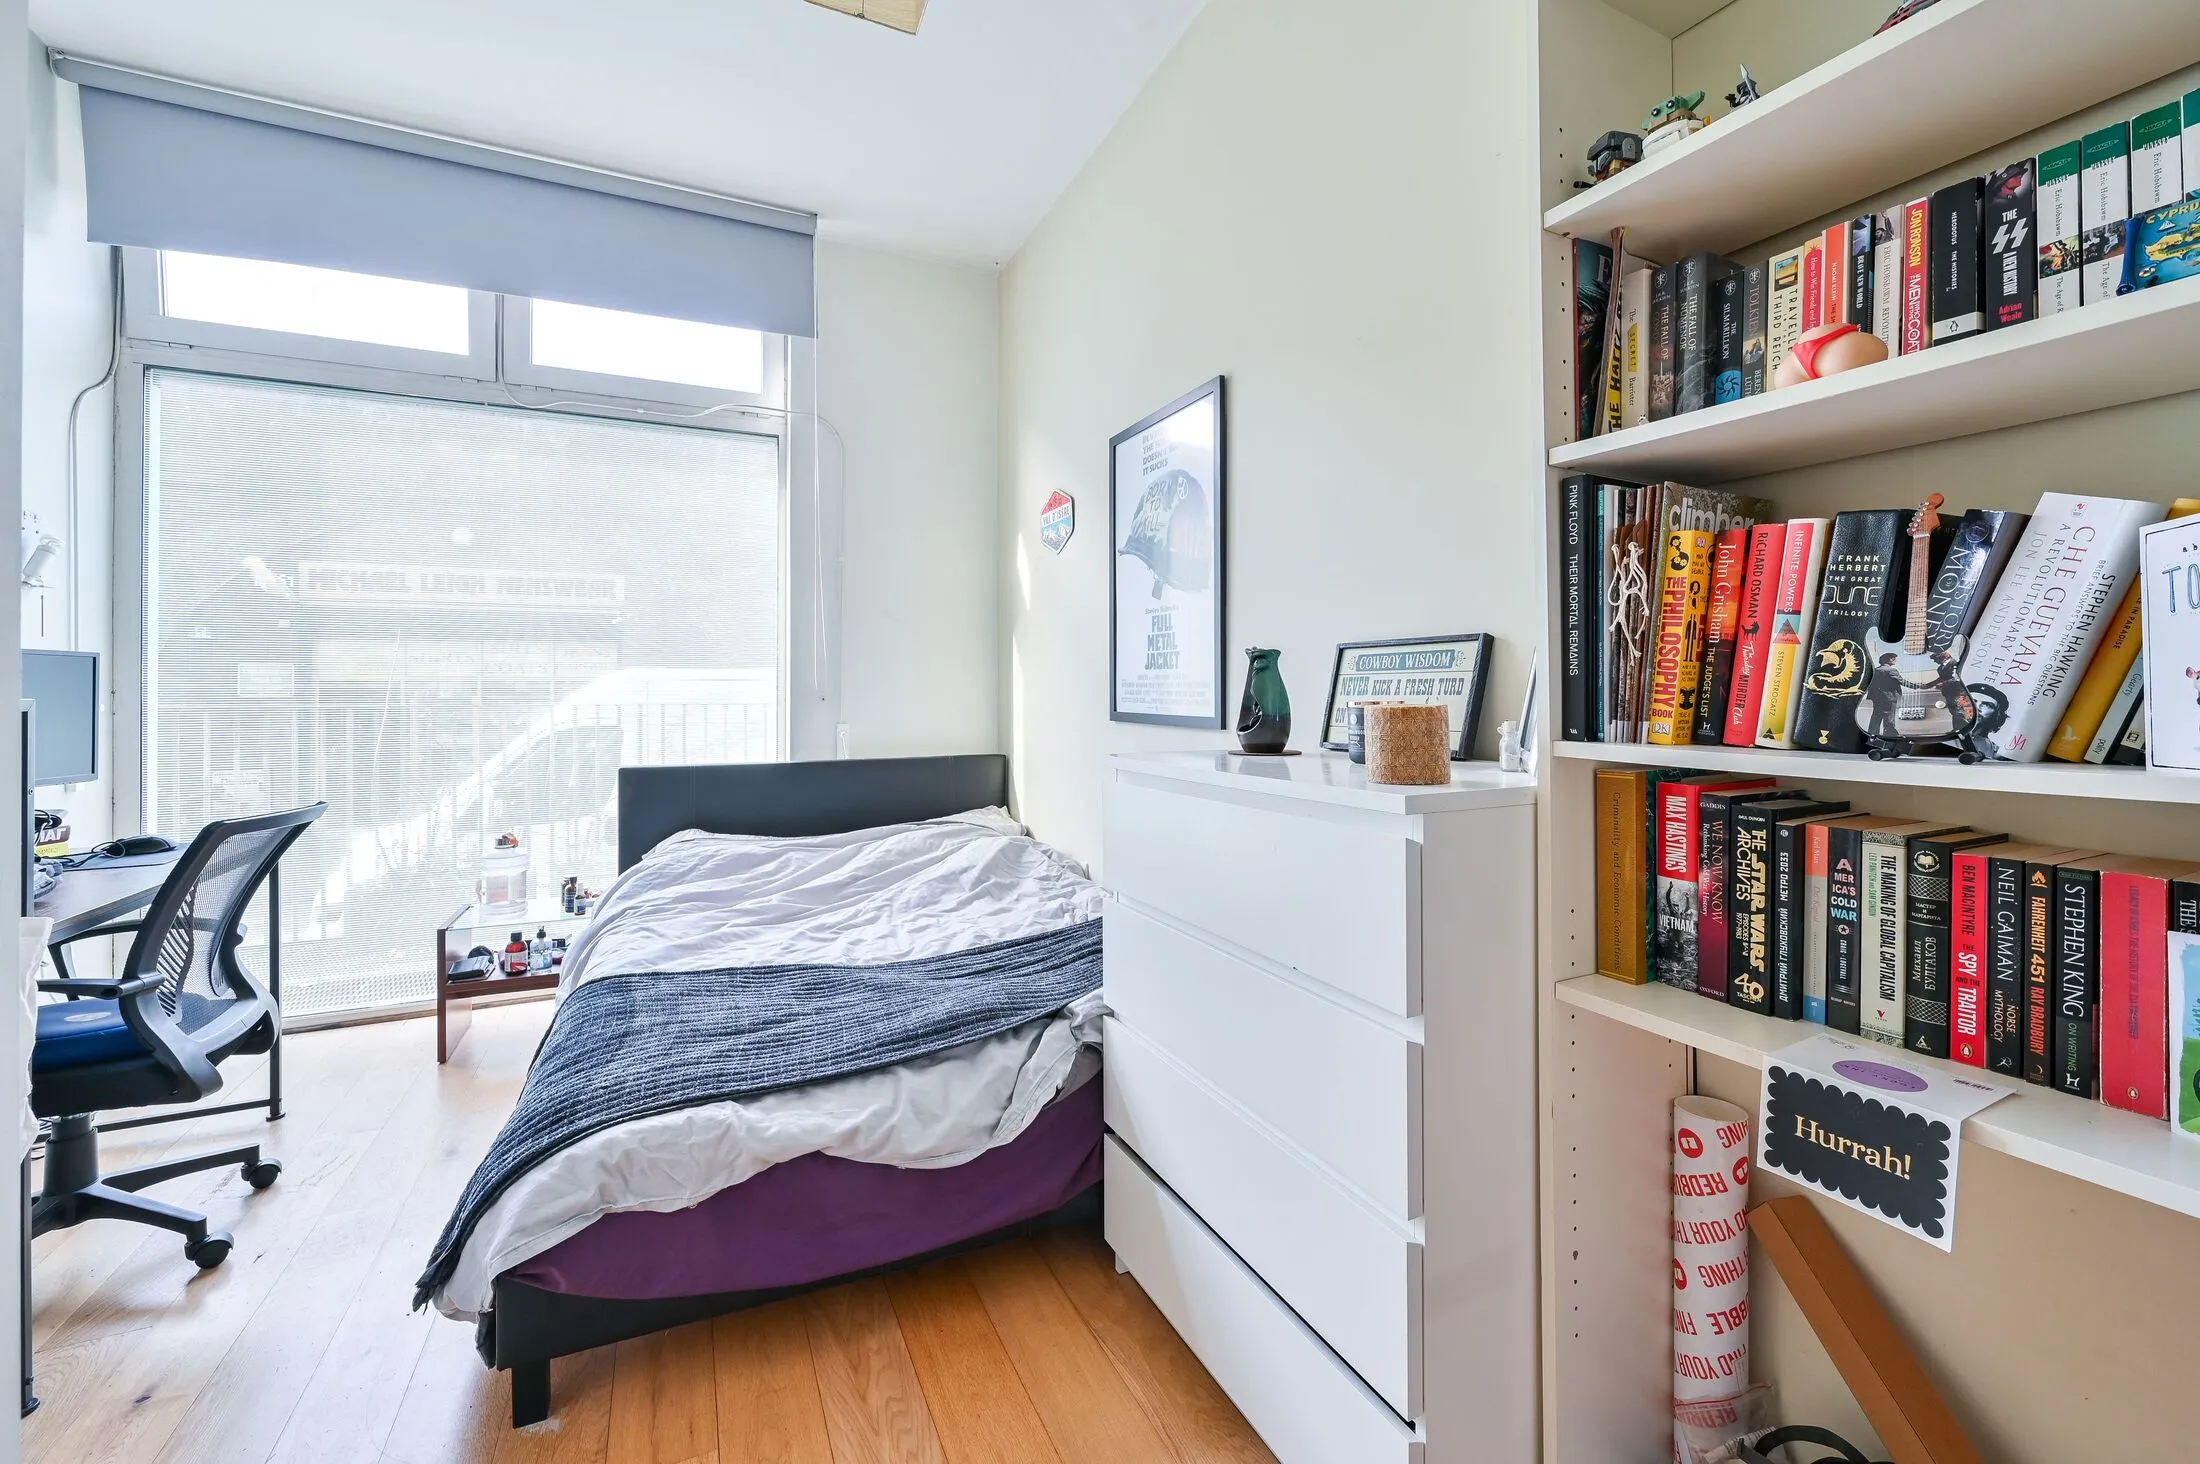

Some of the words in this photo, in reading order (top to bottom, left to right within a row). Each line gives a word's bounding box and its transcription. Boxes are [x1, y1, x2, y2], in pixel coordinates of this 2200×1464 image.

[2153, 168, 2162, 203] Hobsbawm
[2002, 208, 2018, 222] THE
[2100, 187, 2108, 221] Hobsbawm
[1911, 209, 1922, 229] JON
[2055, 203, 2063, 237] Hobsbawm
[1883, 245, 1891, 263] ERIC
[1909, 229, 1922, 267] RONSON
[1883, 264, 1891, 305] HOBSBAWM
[2003, 269, 2017, 296] HISTORY
[1688, 293, 1698, 315] THE
[1749, 284, 1759, 336] TOLKIEN
[1773, 295, 1783, 330] THIRD
[1809, 290, 1817, 309] Friends
[1999, 302, 2023, 315] Adrian
[1661, 304, 1669, 325] THE
[1680, 302, 1689, 351] NÚMENOR
[1688, 315, 1698, 337] FALL
[1661, 327, 1669, 347] FALL
[1722, 302, 1731, 360] SILMARILLION
[1629, 331, 1637, 367] SECRET
[1772, 336, 1782, 370] REICH
[1628, 376, 1637, 407] Barrister
[1149, 458, 1169, 473] SUCKS
[1569, 485, 1578, 514] PINK
[1669, 496, 1755, 532] climber
[1569, 516, 1578, 545] FLOYD
[2060, 523, 2071, 532] A
[1791, 530, 1804, 573] INFINITE
[1838, 554, 1881, 563] FRANK
[2024, 530, 2047, 559] JON
[2060, 525, 2096, 580] CHE
[1569, 553, 1578, 583] THEIR
[1716, 542, 1737, 581] John
[1829, 564, 1887, 573] HERBERT
[2092, 559, 2107, 581] BRIEF
[307, 567, 410, 594] MICHAEL
[420, 571, 486, 595] LEIGH
[496, 574, 616, 600] MENSWEAR
[1666, 577, 1687, 589] THE
[2009, 565, 2030, 588] LEE
[1569, 584, 1578, 630] MORTAL
[1748, 579, 1762, 618] OSMAN
[1783, 573, 1797, 613] POWERS
[1821, 584, 1884, 607] DUNE
[2000, 538, 2066, 653] REVOLUTIONARY
[2071, 581, 2094, 619] ANSWERS
[2075, 573, 2116, 632] STEPHEN
[1152, 613, 1173, 633] FULL
[1708, 583, 1732, 644] Grisham
[1828, 609, 1869, 617] TRILOGY
[1147, 632, 1178, 652] METAL
[1970, 594, 2010, 669] ANDERSON
[2001, 585, 2067, 688] GUEVARA
[2112, 616, 2135, 650] PARADISE
[1144, 651, 1180, 671] JACKET
[1359, 654, 1401, 670] COWBOY
[1405, 652, 1452, 669] WISDOM
[1569, 631, 1578, 676] REMAINS
[1653, 589, 1685, 710] PHILOSOPHY
[1707, 646, 1716, 664] THE
[1776, 651, 1785, 679] STEVEN
[1984, 658, 2005, 684] LIFE
[2042, 635, 2085, 698] HAWKING
[1340, 677, 1369, 696] NEVER
[1371, 679, 1393, 695] KICK
[1394, 679, 1402, 695] A
[1403, 678, 1435, 696] FRESH
[1437, 678, 1464, 695] TURD
[1702, 664, 1714, 702] JUDGE'S
[1735, 674, 1750, 709] MURDER
[2028, 664, 2053, 706] QUESTIONS
[2122, 672, 2143, 697] Gearty
[1652, 708, 1674, 719] BOOK
[1700, 702, 1708, 718] LIST
[1769, 679, 1781, 719] STROGATZ
[1652, 723, 1671, 736] DK
[1732, 707, 1743, 725] Club
[1612, 792, 1621, 847] Criminality
[1665, 795, 1687, 821] MAX
[1700, 801, 1726, 810] GADDIS
[1701, 823, 1710, 859] Rethinking
[1712, 820, 1723, 842] WE
[1751, 829, 1767, 852] THE
[1665, 821, 1687, 874] HASTINGS
[1712, 844, 1723, 878] NOW
[1702, 859, 1710, 876] Cold
[1736, 826, 1751, 901] ARCHIVES
[1780, 852, 1789, 874] 2033
[1836, 858, 1853, 872] A
[1868, 861, 1877, 882] PANITCH
[1881, 855, 1897, 870] THE
[1962, 864, 1976, 884] BEN
[1613, 870, 1621, 912] Economic
[1750, 853, 1766, 912] STAR
[1780, 875, 1789, 902] МЕТРО
[1832, 885, 1857, 896] ICA'S
[1834, 872, 1855, 884] MER
[1881, 872, 1897, 906] MAKING
[1997, 866, 2015, 905] NEIL
[1701, 891, 1709, 917] History
[1711, 881, 1723, 925] KNOW
[1830, 907, 1858, 922] WAR
[1831, 896, 1858, 909] COLD
[1881, 906, 1896, 919] OF
[1911, 912, 1942, 921] МАРГАРИТА
[1915, 902, 1936, 910] МАСТЕР
[1961, 886, 1975, 937] MACINTYRE
[2180, 899, 2197, 928] THE
[1659, 913, 1695, 933] VIETNAM
[1778, 907, 1789, 962] ГЛУХОВСКИЙ
[1881, 918, 1896, 949] GLOBAL
[2030, 895, 2046, 954] FAHRENHEIT
[2064, 883, 2085, 965] STEPHEN
[1750, 914, 1766, 973] WARS
[1839, 939, 1847, 954] CRAIG
[1962, 944, 1975, 952] THE
[1996, 909, 2015, 982] GAIMAN
[1912, 940, 1922, 982] Михаил
[1924, 936, 1937, 991] БУЛГАКОВ
[1958, 952, 1978, 977] SPY
[2030, 955, 2045, 984] 451
[1734, 972, 1765, 1000] 40
[1778, 962, 1789, 1003] ДМИТРИЙ
[1880, 950, 1896, 1002] CAPITALISM
[1955, 976, 1968, 985] AND
[1968, 978, 1981, 987] THE
[1700, 986, 1725, 997] OXFORD
[2030, 985, 2044, 1002] RAY
[2063, 969, 2084, 1018] KING
[1957, 987, 1977, 1036] TRAITOR
[1993, 989, 2003, 1043] MYTHOLOGY
[2007, 1003, 2016, 1035] NORSE
[2029, 1002, 2044, 1057] BRADBURY
[2068, 1022, 2077, 1034] ON
[2067, 1035, 2076, 1072] WRITING
[1794, 1113, 1913, 1181] Hurrah!
[1692, 1218, 1738, 1246] YOUR
[1698, 1258, 1746, 1289] THING
